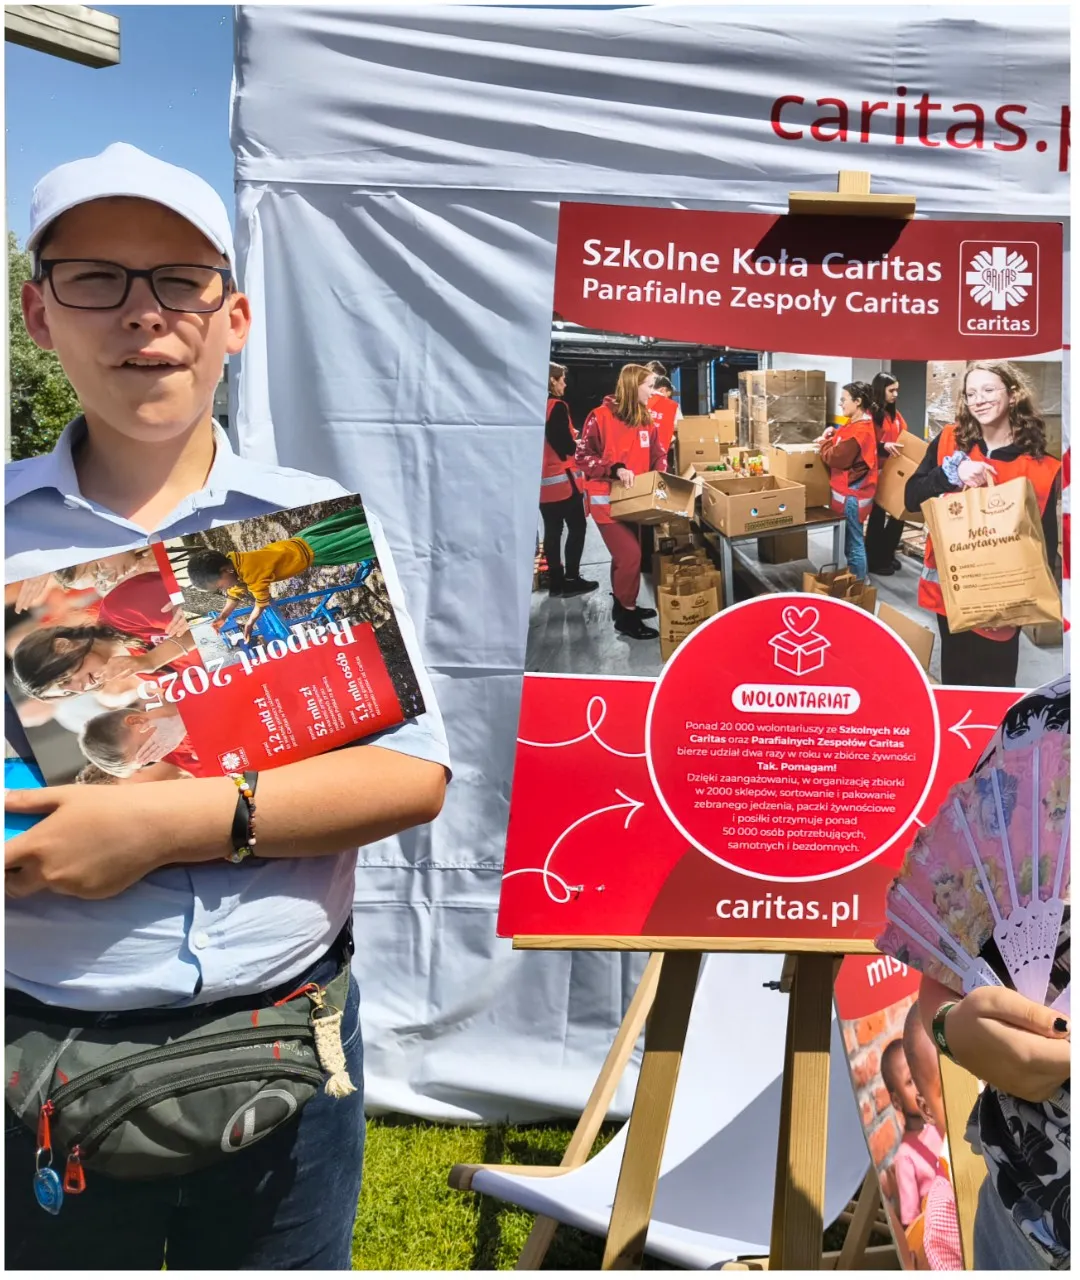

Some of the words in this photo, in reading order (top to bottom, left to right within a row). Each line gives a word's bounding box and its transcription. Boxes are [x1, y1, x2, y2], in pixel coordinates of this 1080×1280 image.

[583, 238, 720, 273] Szkolne
[733, 247, 808, 278] Koła
[821, 252, 942, 282] Caritas
[583, 277, 721, 306] Parafialne
[730, 286, 837, 317] Zespoły
[845, 291, 940, 315] Caritas
[967, 315, 1030, 331] caritas
[233, 617, 358, 676] Raport
[336, 652, 353, 679] osób
[137, 656, 232, 712] 2025
[299, 686, 312, 698] zł
[348, 680, 362, 702] mln
[254, 697, 267, 709] zł
[742, 690, 851, 710] WOLONTARIAT
[307, 701, 321, 720] mln
[355, 703, 369, 722] 1,1
[258, 710, 276, 732] mld
[314, 721, 328, 737] 52
[686, 721, 718, 731] Ponad
[720, 722, 732, 731] 20
[735, 723, 754, 732] 000
[756, 723, 824, 735] wolontariuszy
[826, 726, 837, 734] ze
[839, 725, 890, 736] Szkolnych
[893, 726, 911, 736] Kół
[269, 733, 284, 753] 1,2
[690, 734, 726, 744] Caritas
[728, 736, 749, 744] oraz
[751, 736, 815, 747] Parafialnych
[817, 737, 867, 749] Zespołów
[869, 739, 905, 748] Caritas
[677, 747, 708, 757] bierze
[710, 748, 740, 758] udział
[742, 748, 764, 758] dwa
[765, 750, 784, 760] razy
[799, 749, 820, 759] roku
[834, 750, 870, 760] zbiórce
[872, 751, 916, 763] żywności
[756, 761, 779, 771] Tak.
[780, 762, 837, 773] Pomagam!
[687, 773, 718, 784] Dzięki
[720, 774, 799, 786] zaangażowaniu,
[813, 776, 869, 788] organizację
[706, 787, 732, 796] 2000
[734, 787, 777, 798] sklepów,
[779, 788, 835, 798] sortowanie
[842, 789, 896, 800] pakowanie
[694, 800, 748, 811] zebranego
[749, 800, 794, 811] jedzenia,
[796, 802, 828, 813] paczki
[737, 814, 770, 825] posiłki
[771, 816, 823, 827] otrzymuje
[825, 816, 857, 827] ponad
[722, 827, 735, 836] 50
[737, 827, 758, 837] 000
[760, 827, 785, 838] osób
[727, 841, 785, 852] samotnych
[792, 842, 860, 853] bezdomnych.
[715, 893, 859, 927] caritas.pl
